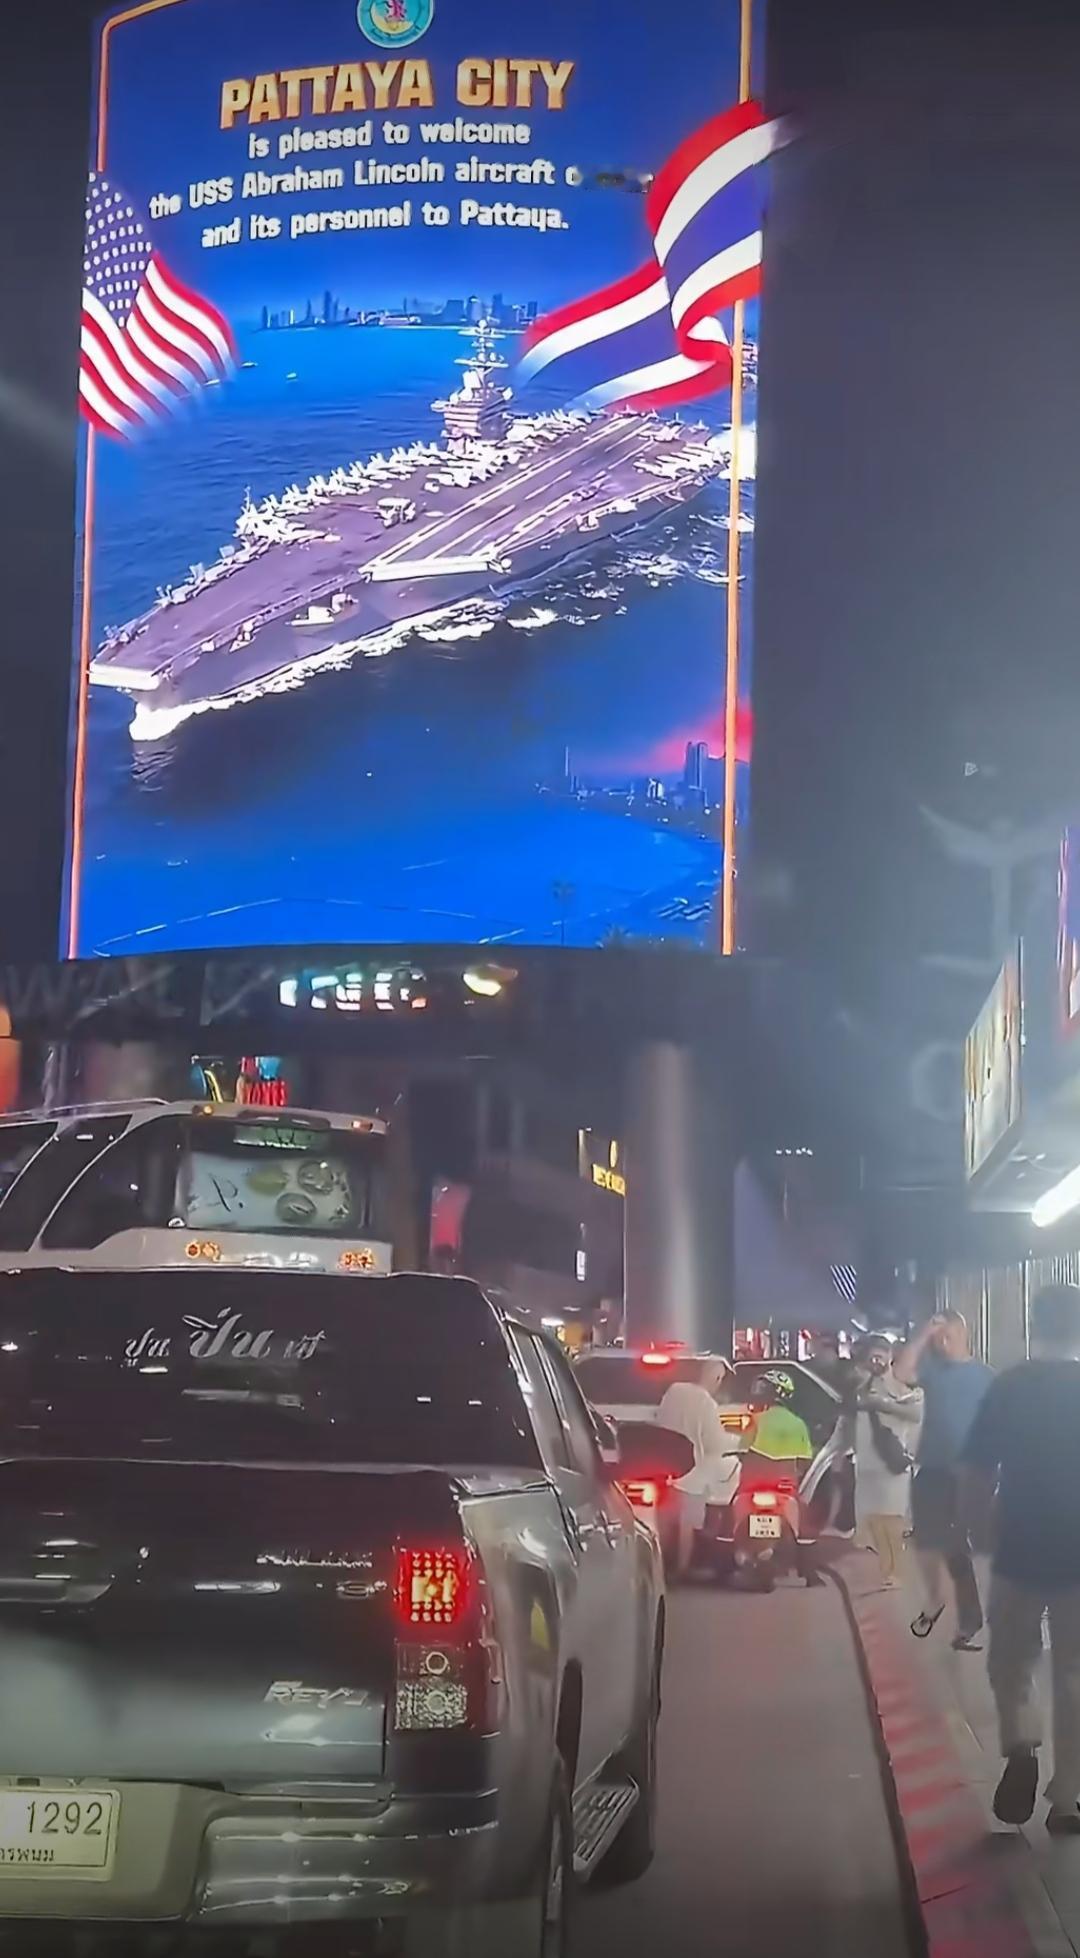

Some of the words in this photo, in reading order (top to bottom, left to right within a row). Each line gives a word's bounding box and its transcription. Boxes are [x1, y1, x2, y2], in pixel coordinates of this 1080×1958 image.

[219, 58, 435, 130] PATTAYA
[456, 57, 575, 110] CITY
[249, 132, 270, 160] is
[279, 119, 372, 159] pleased
[383, 120, 410, 144] to
[420, 116, 531, 145] welcome
[149, 192, 182, 220] the
[189, 176, 234, 209] USS
[242, 165, 344, 199] Abraham
[354, 155, 444, 186] Lincoln
[455, 155, 555, 185] aircraft
[201, 217, 240, 248] and
[250, 214, 281, 240] its
[290, 200, 411, 239] personnel
[422, 201, 449, 226] to
[460, 199, 569, 232] Pattaya.
[27, 1801, 103, 1835] 1292
